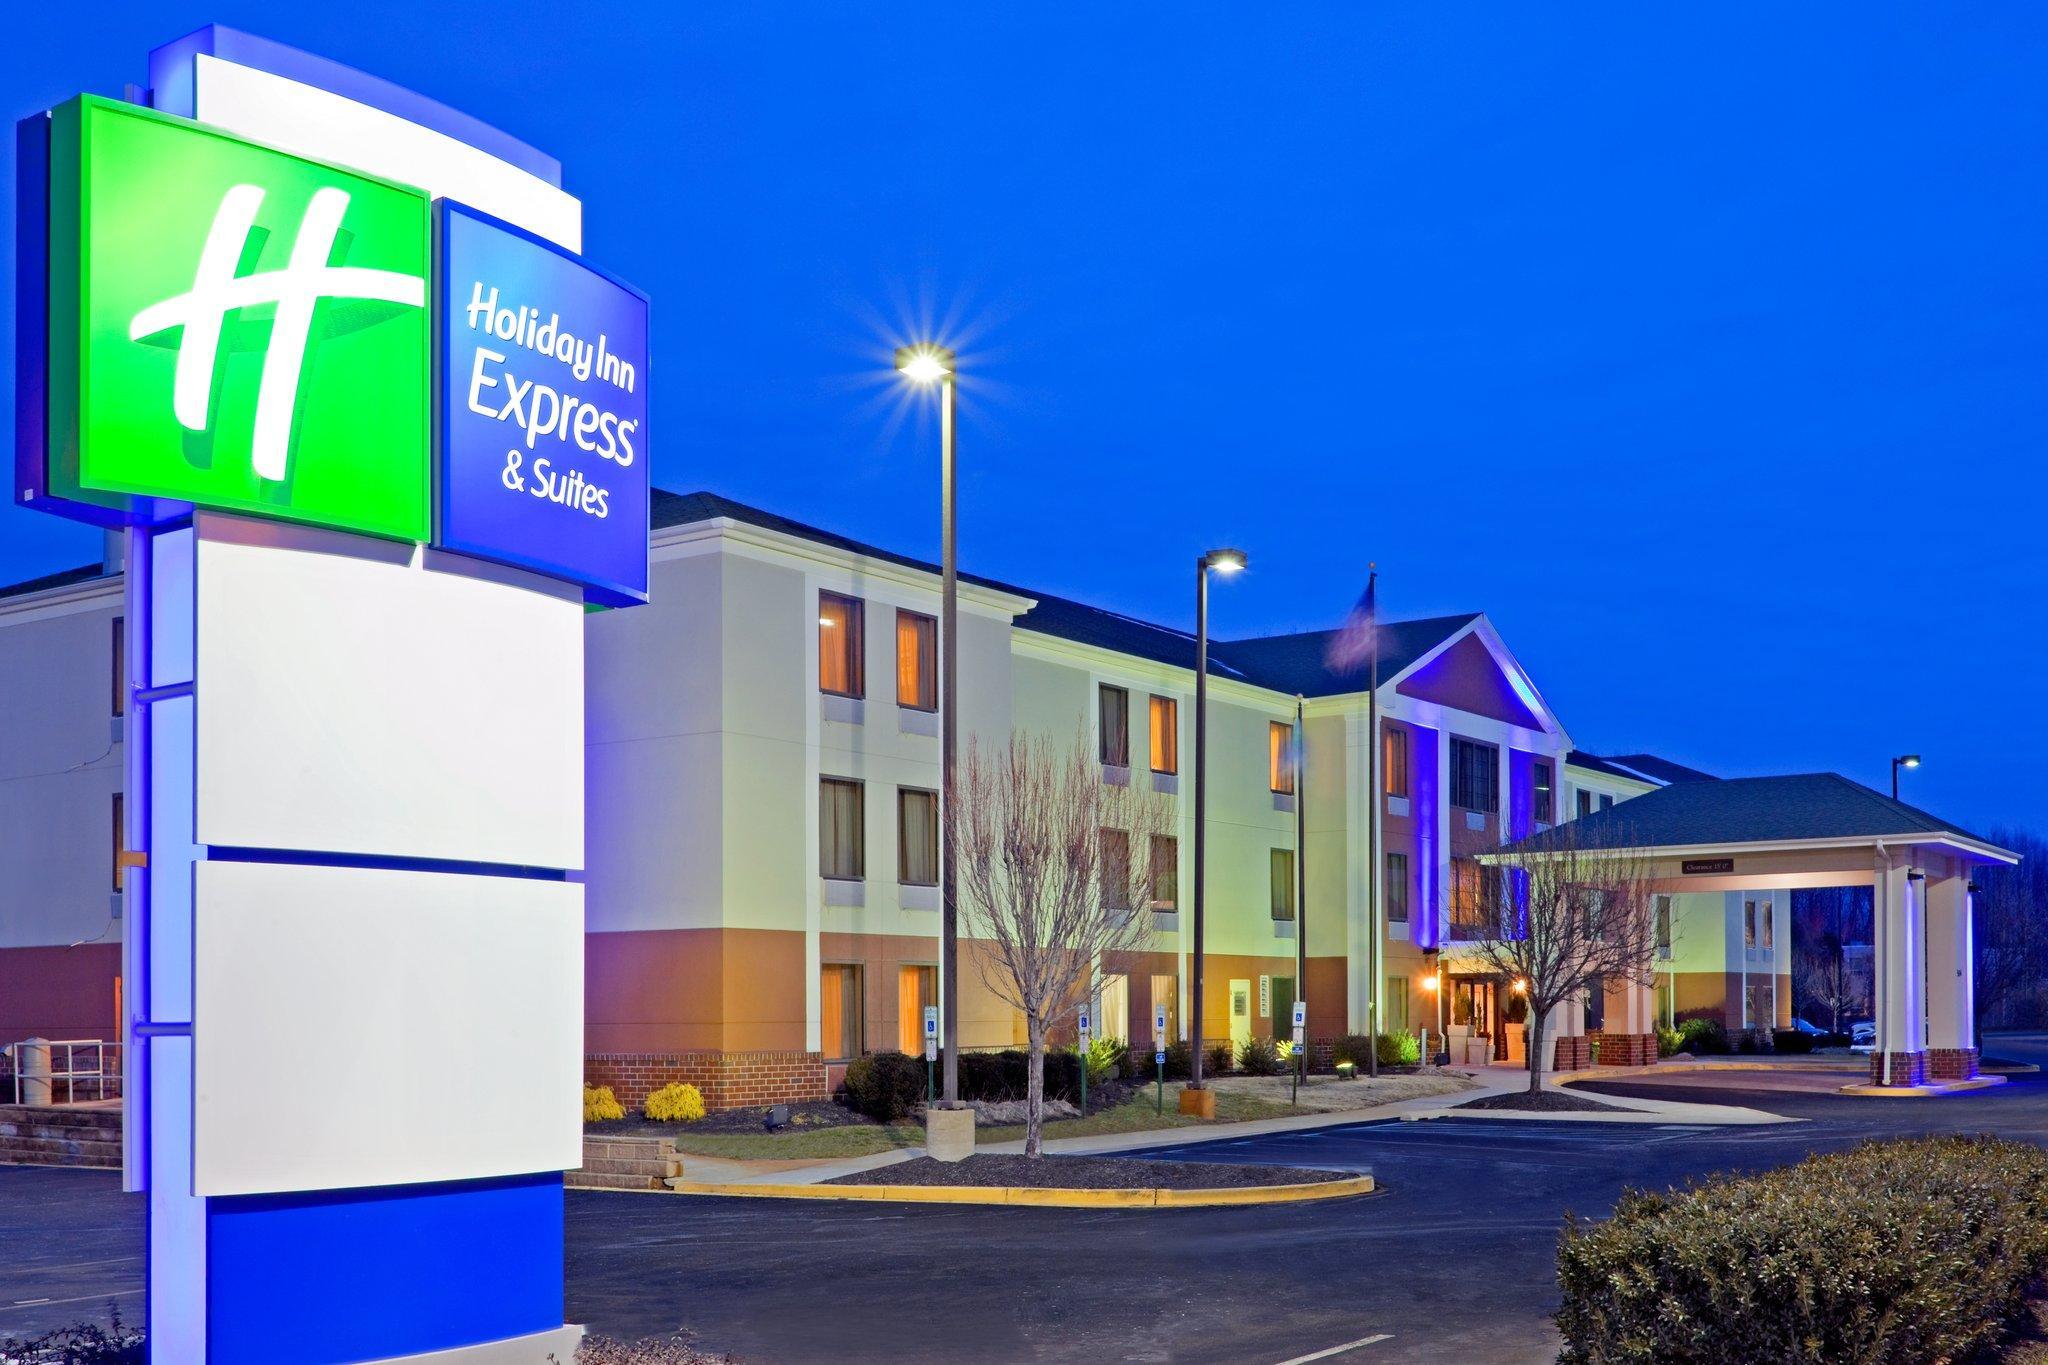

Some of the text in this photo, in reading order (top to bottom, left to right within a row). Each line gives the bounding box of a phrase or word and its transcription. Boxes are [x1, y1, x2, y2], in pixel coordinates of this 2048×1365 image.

[467, 281, 635, 393] Holiday Inn
[468, 346, 637, 467] Express
[502, 449, 610, 518] & Suites
